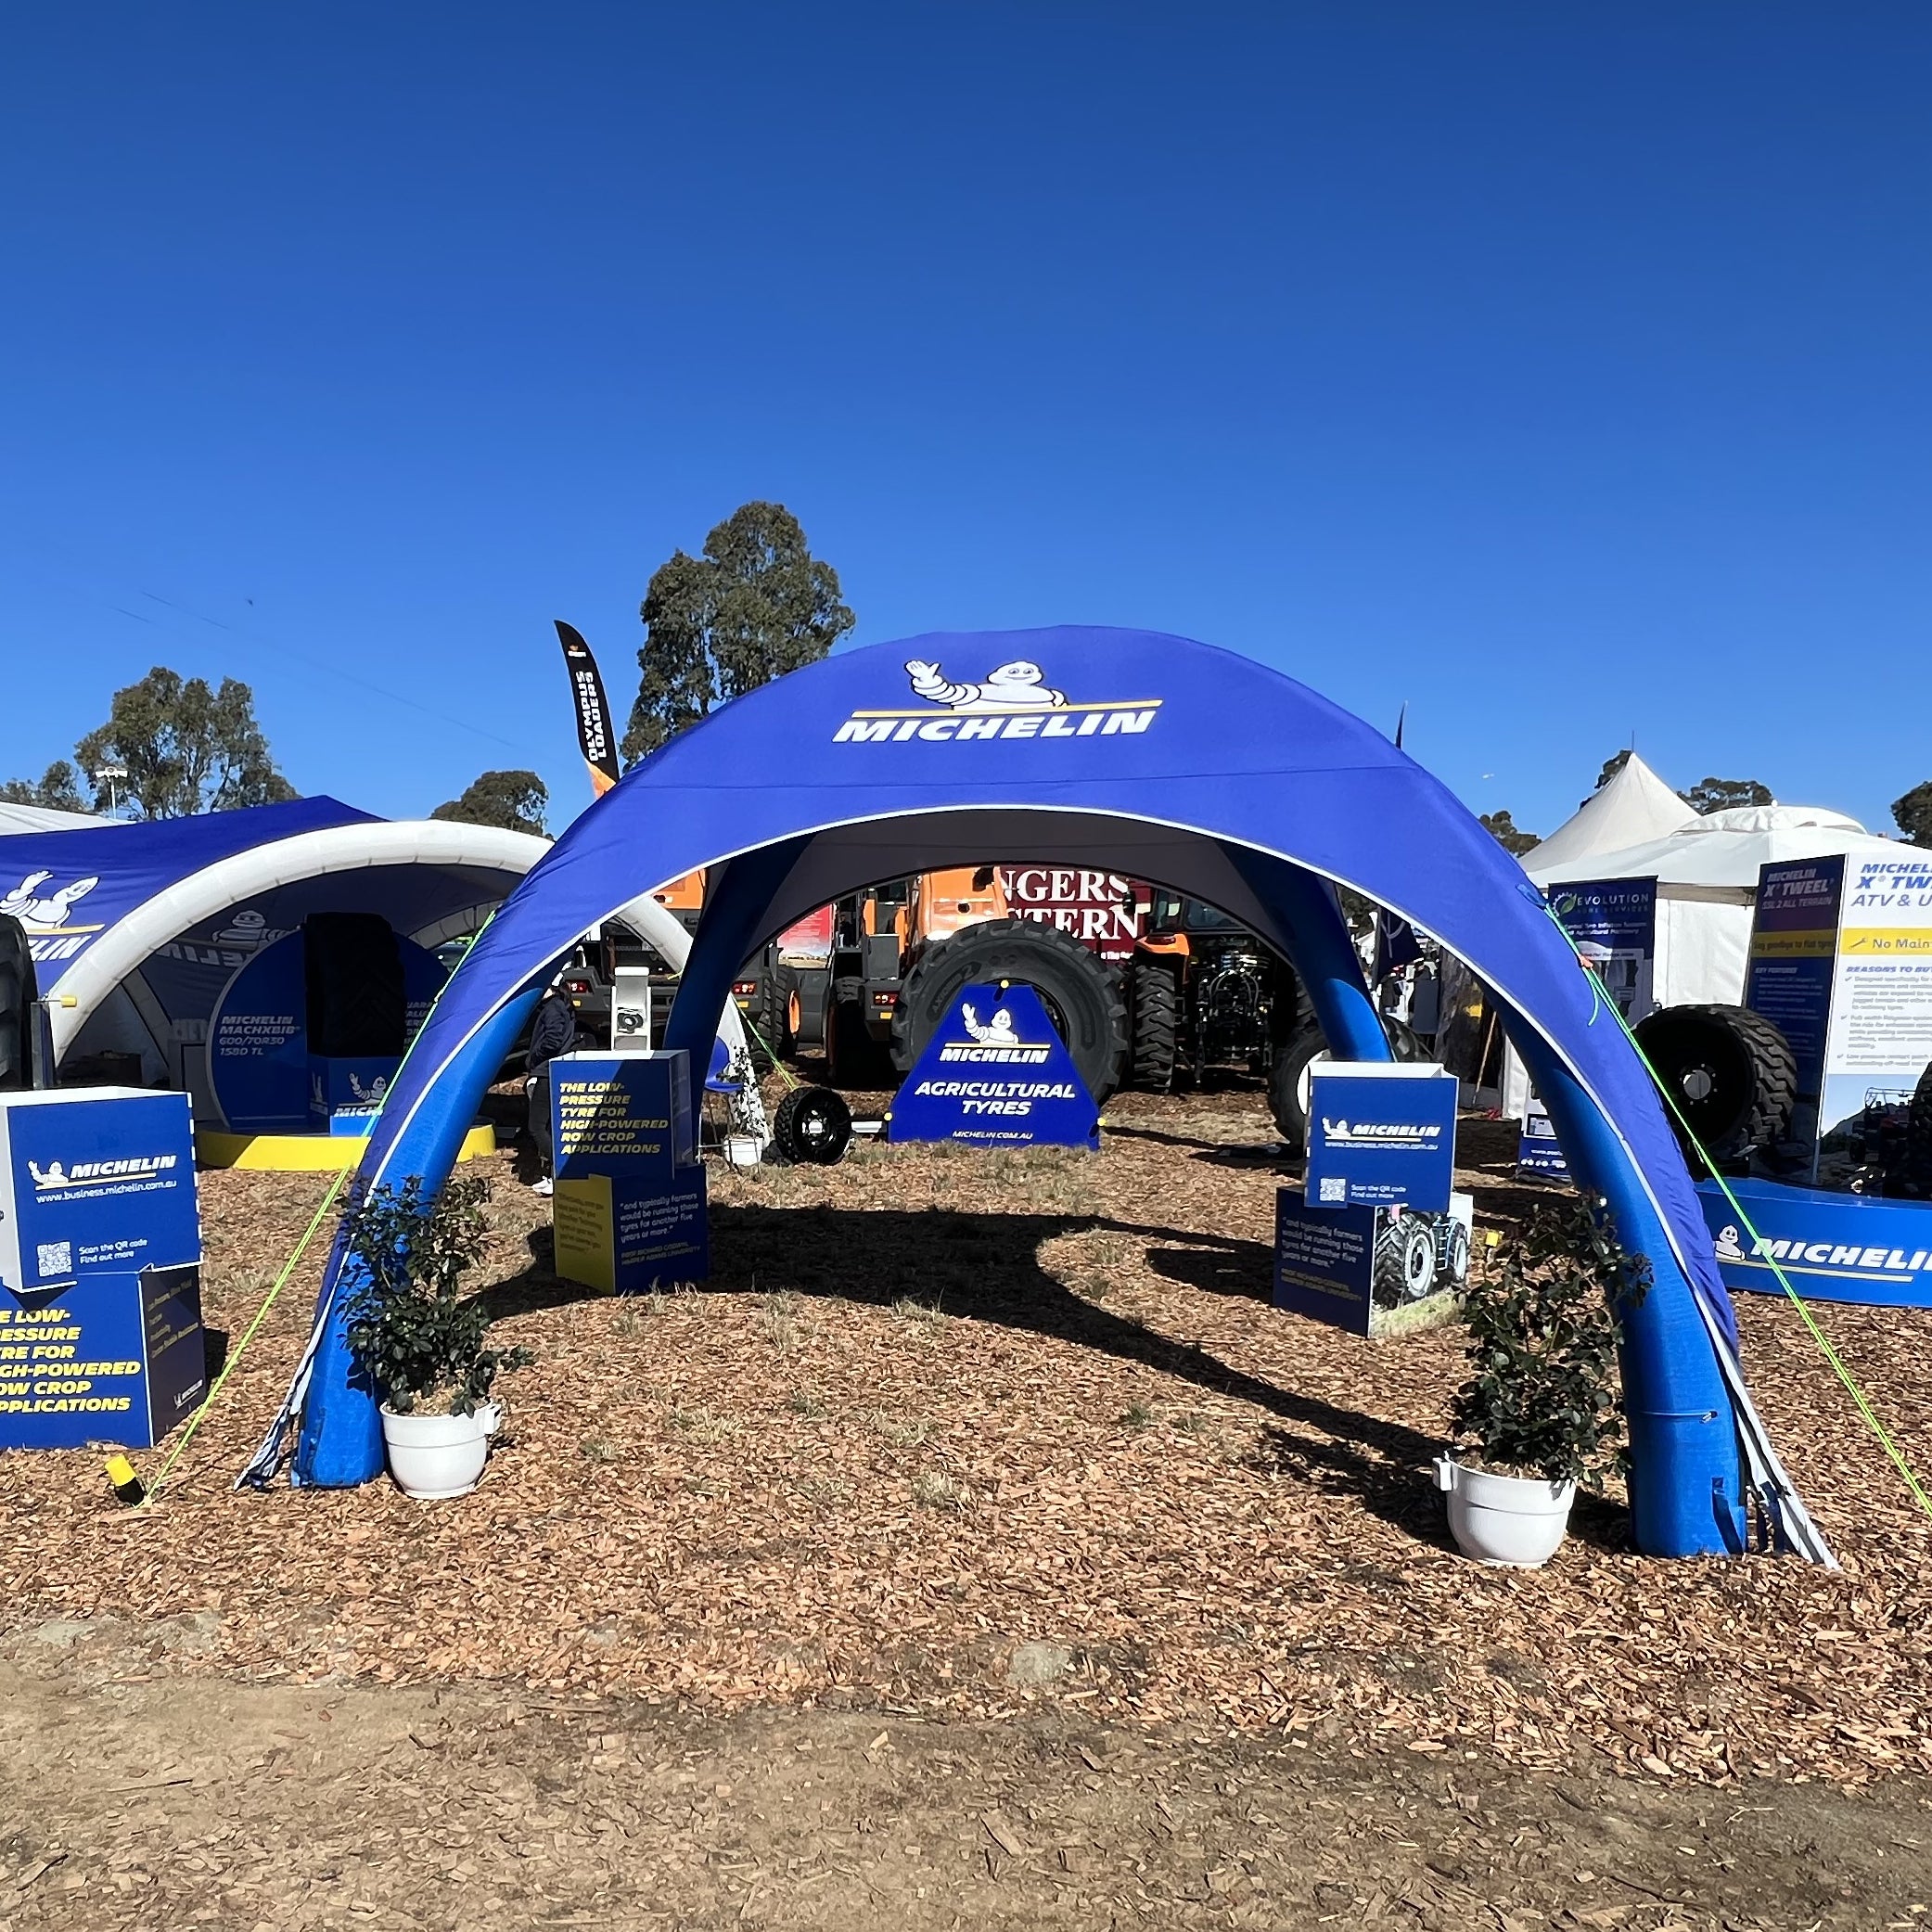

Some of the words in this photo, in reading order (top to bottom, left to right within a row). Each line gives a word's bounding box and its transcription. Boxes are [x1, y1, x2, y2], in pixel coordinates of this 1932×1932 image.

[575, 671, 599, 761] OLYMPUS
[584, 672, 607, 759] LOADERS
[832, 710, 1156, 742] MICHELIN
[1766, 868, 1816, 883] MICHELIN
[1861, 864, 1932, 874] MICHEL
[1891, 876, 1932, 889] TW
[1578, 893, 1649, 906] EVOLUTION
[1850, 894, 1895, 906] ATV
[1897, 894, 1911, 906] &
[1873, 939, 1891, 948] No
[222, 1016, 293, 1025] MICHELIN
[219, 1036, 285, 1045] 600/70R30
[251, 1047, 264, 1056] TL
[940, 1048, 1049, 1064] MICHELIN
[559, 1082, 586, 1093] THE
[588, 1082, 625, 1093] LOW-
[915, 1081, 1075, 1098] AGRICULTURAL
[559, 1095, 631, 1105] PRESSURE
[560, 1107, 596, 1118] TYRE
[598, 1107, 627, 1117] FOR
[962, 1100, 1032, 1116] TYRES
[560, 1120, 669, 1130] HIGH-POWERED
[1351, 1125, 1440, 1137] MICHELIN
[561, 1132, 595, 1142] ROW
[597, 1132, 636, 1142] CROP
[953, 1131, 1033, 1140] MICHELIN.COM.AU
[561, 1145, 661, 1155] APPLICATIONS
[70, 1155, 177, 1179] MICHELIN
[35, 1180, 177, 1204] www.business.michelin.com.au
[1379, 1184, 1390, 1193] QR
[79, 1244, 98, 1255] Scan
[100, 1243, 114, 1253] the
[114, 1240, 128, 1251] QR
[129, 1238, 147, 1248] code
[80, 1253, 97, 1264] Find
[98, 1252, 113, 1262] out
[114, 1250, 134, 1260] more
[15, 1310, 70, 1324] LOW-
[32, 1345, 76, 1359] FOR
[33, 1380, 92, 1394] CROP
